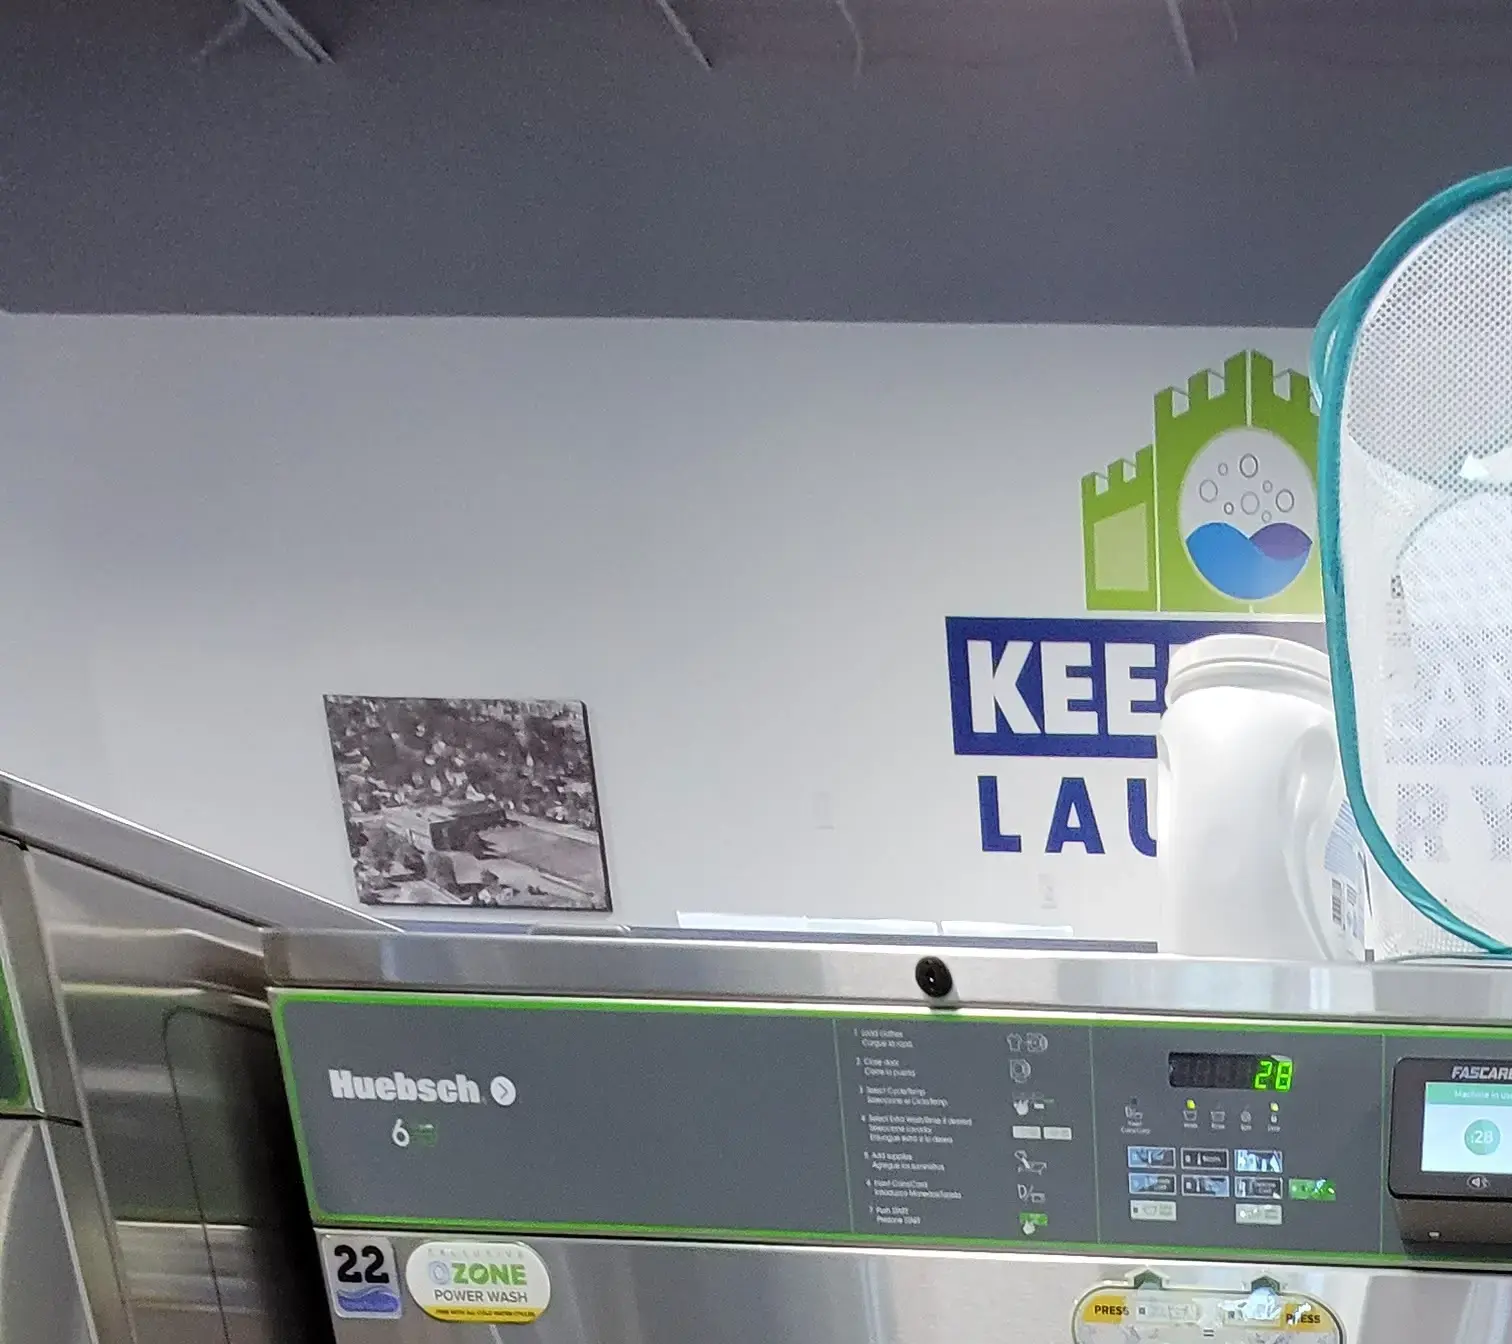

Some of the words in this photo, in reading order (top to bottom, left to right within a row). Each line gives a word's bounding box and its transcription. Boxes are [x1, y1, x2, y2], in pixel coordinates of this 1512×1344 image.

[966, 639, 1158, 736] KEE
[328, 1068, 480, 1103] Huebsch
[1254, 1060, 1293, 1092] 28
[334, 1244, 390, 1284] 22
[428, 1260, 528, 1286] OZONE
[434, 1289, 484, 1302] POWER
[487, 1290, 528, 1303] WASH
[1094, 1304, 1130, 1316] PRESS
